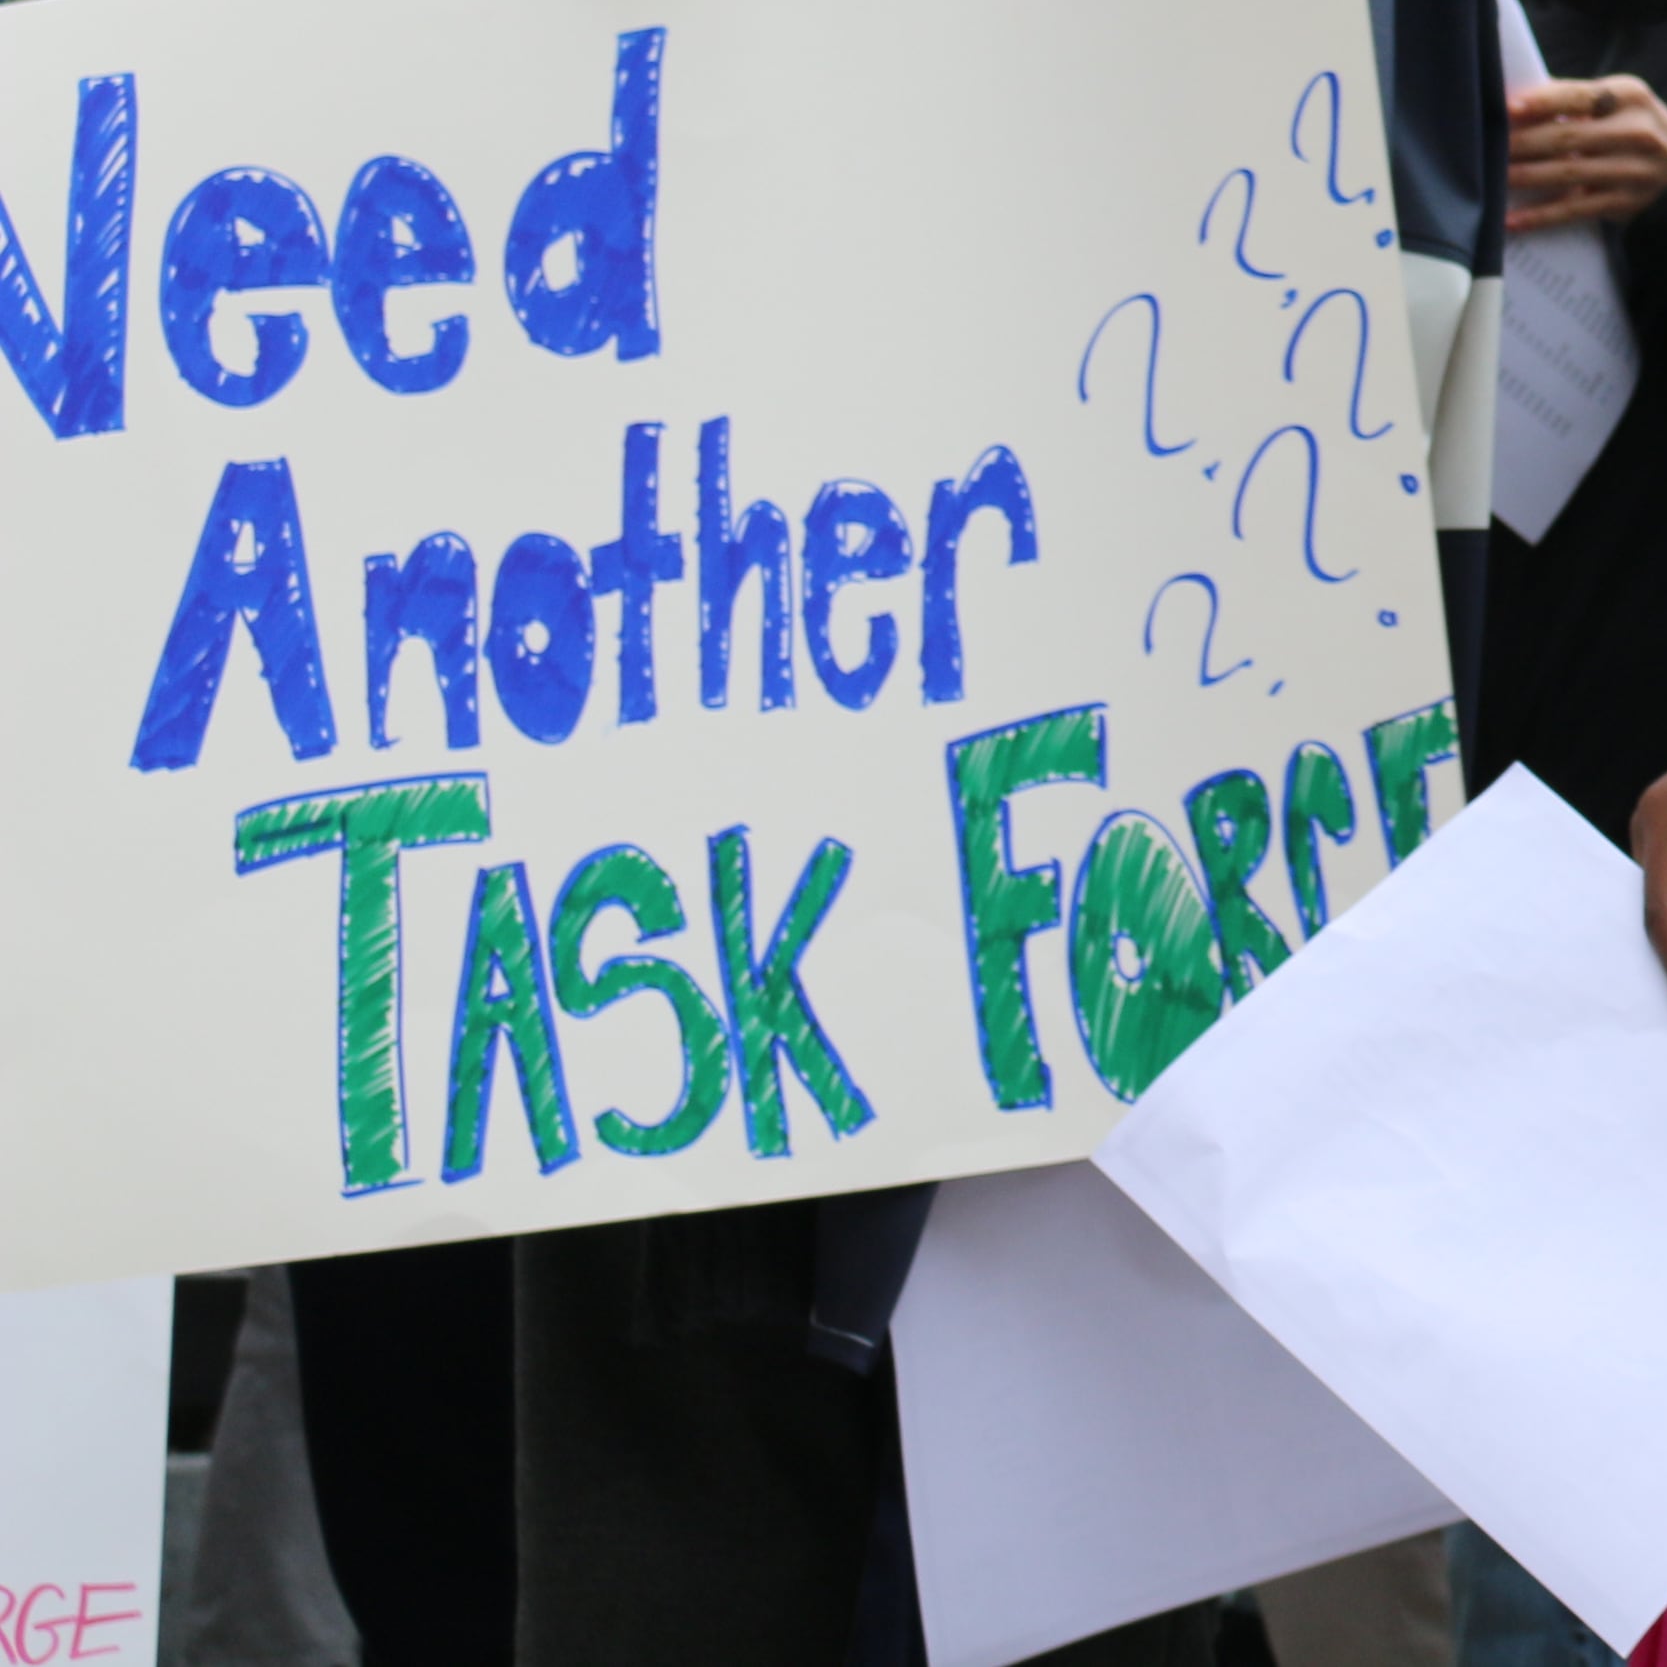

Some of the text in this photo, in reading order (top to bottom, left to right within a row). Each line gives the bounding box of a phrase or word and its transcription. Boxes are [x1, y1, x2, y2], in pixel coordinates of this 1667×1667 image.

[0, 24, 668, 441] Need
[128, 416, 1040, 774] Another
[233, 771, 878, 1198] TASK
